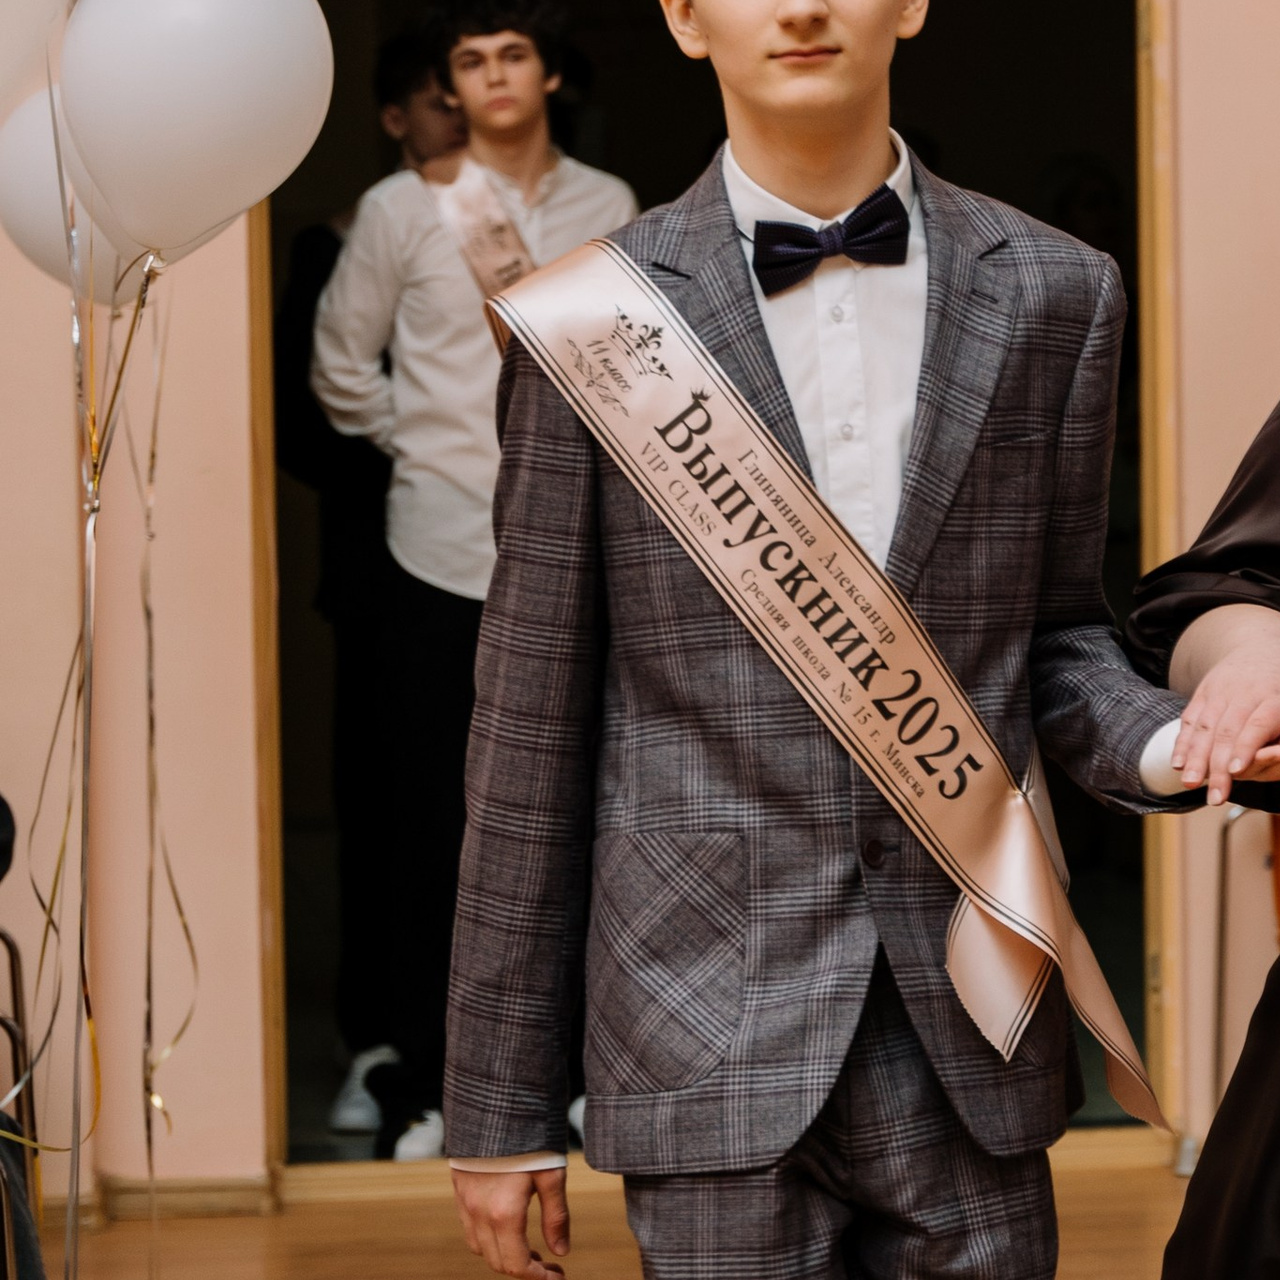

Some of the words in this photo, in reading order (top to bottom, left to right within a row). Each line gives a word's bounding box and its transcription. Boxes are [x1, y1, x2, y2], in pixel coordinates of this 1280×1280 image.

[586, 339, 610, 356] 11
[600, 357, 633, 393] класс
[639, 441, 669, 475] VIP
[667, 478, 717, 537] CLASS
[818, 551, 897, 646] Александр
[740, 568, 792, 632] Средняя
[791, 635, 832, 681] школа
[833, 681, 853, 705] №
[852, 705, 873, 726] 15
[868, 728, 881, 743] г.
[882, 741, 926, 799] Минска
